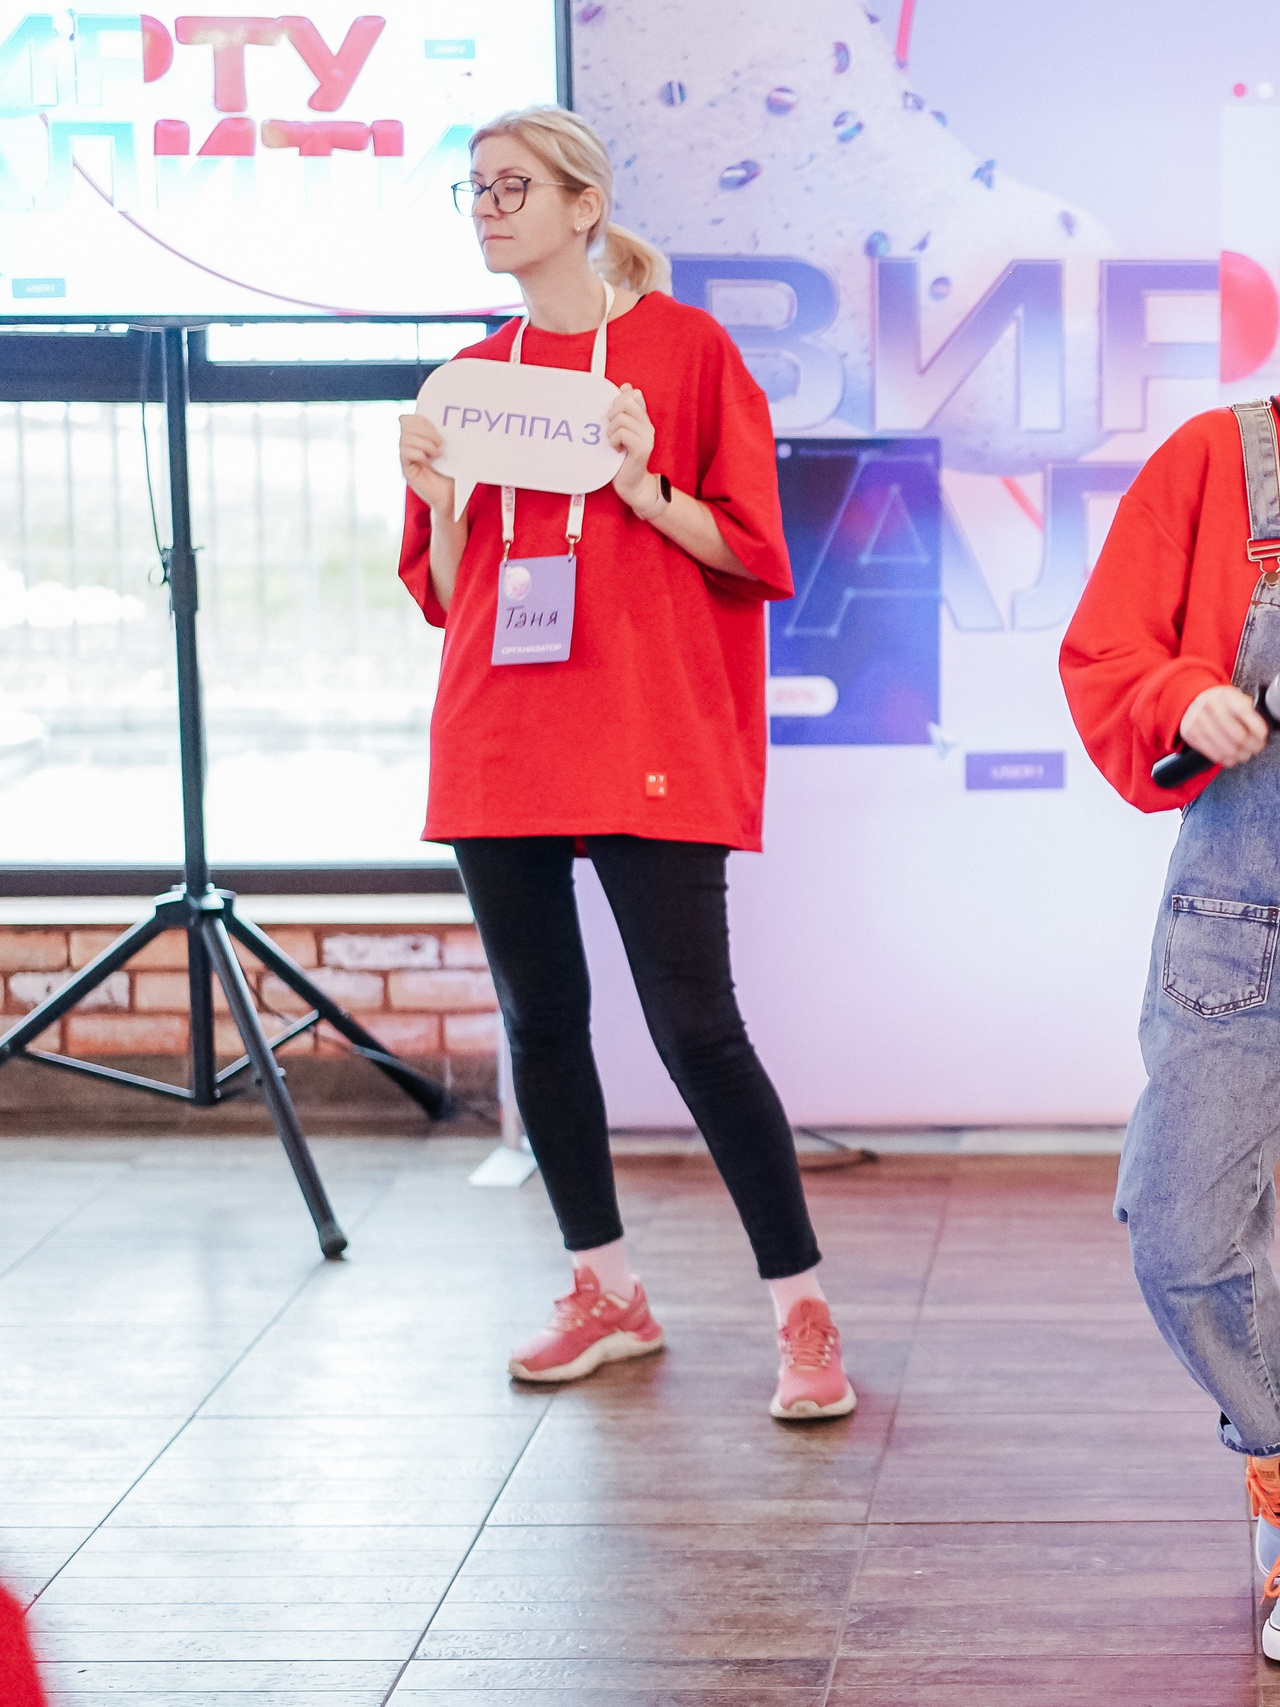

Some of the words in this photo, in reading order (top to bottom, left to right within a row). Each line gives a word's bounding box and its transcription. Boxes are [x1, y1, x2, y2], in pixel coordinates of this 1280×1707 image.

[0, 117, 475, 213] ЛИТИ
[442, 405, 573, 443] ГРУППА
[582, 422, 601, 446] 3
[506, 604, 558, 629] Таня
